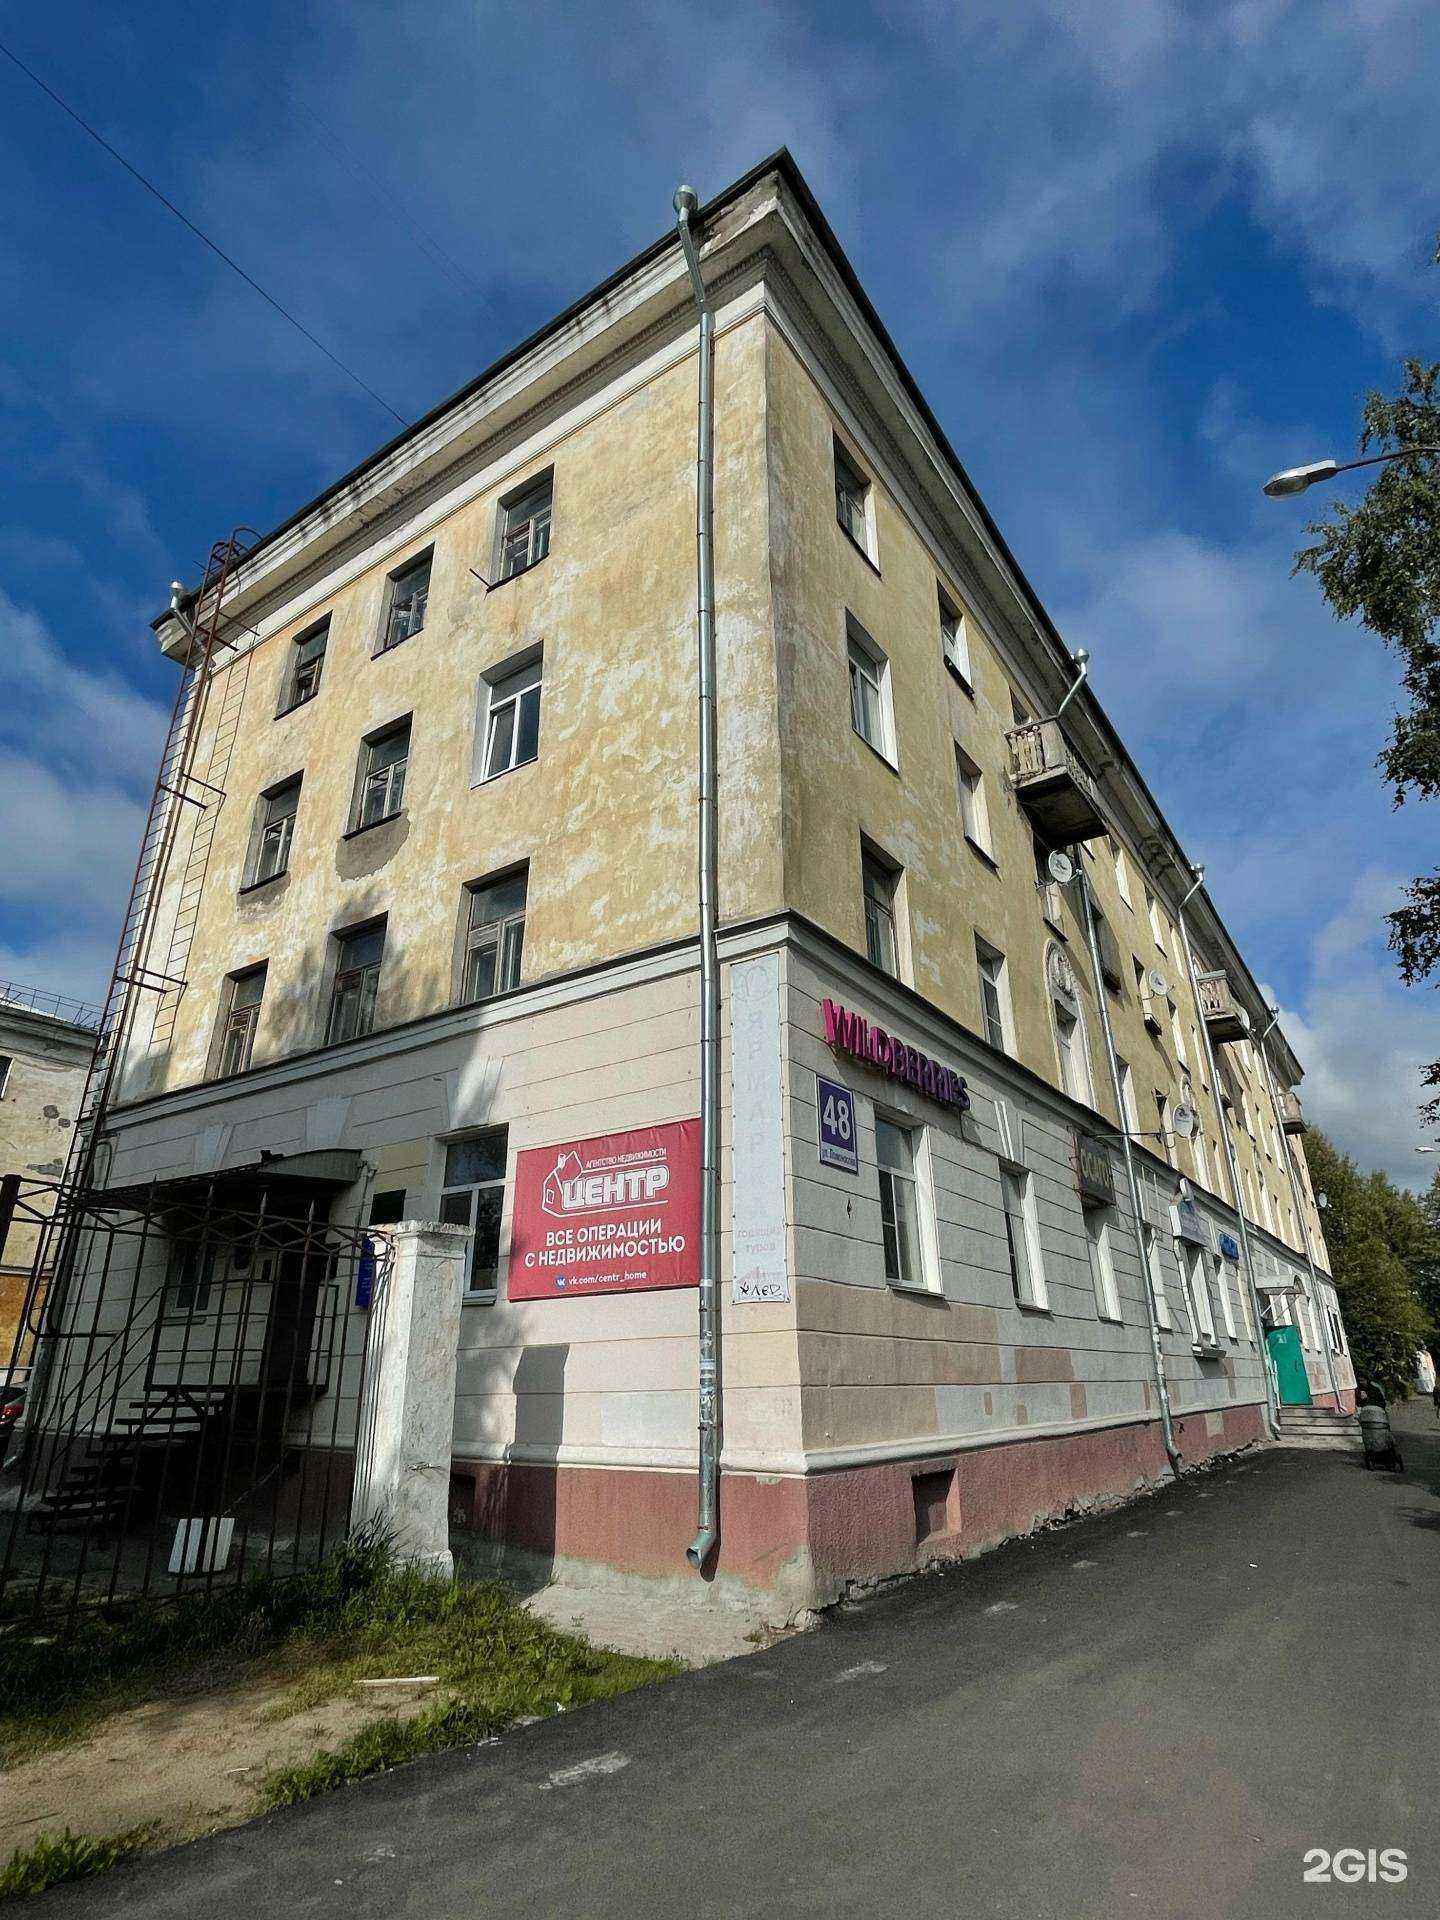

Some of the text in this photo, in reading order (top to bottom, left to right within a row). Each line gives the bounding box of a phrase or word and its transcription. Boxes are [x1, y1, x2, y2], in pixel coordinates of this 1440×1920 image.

[823, 1095, 851, 1140] 48
[562, 1165, 669, 1210] ЦЕНТР
[546, 1218, 662, 1247] ВСЕ ОПЕРАЦИИ
[524, 1235, 686, 1268] С НЕДВИЖИМОСТЬЮ
[568, 1270, 648, 1286] vk.com/centr_home
